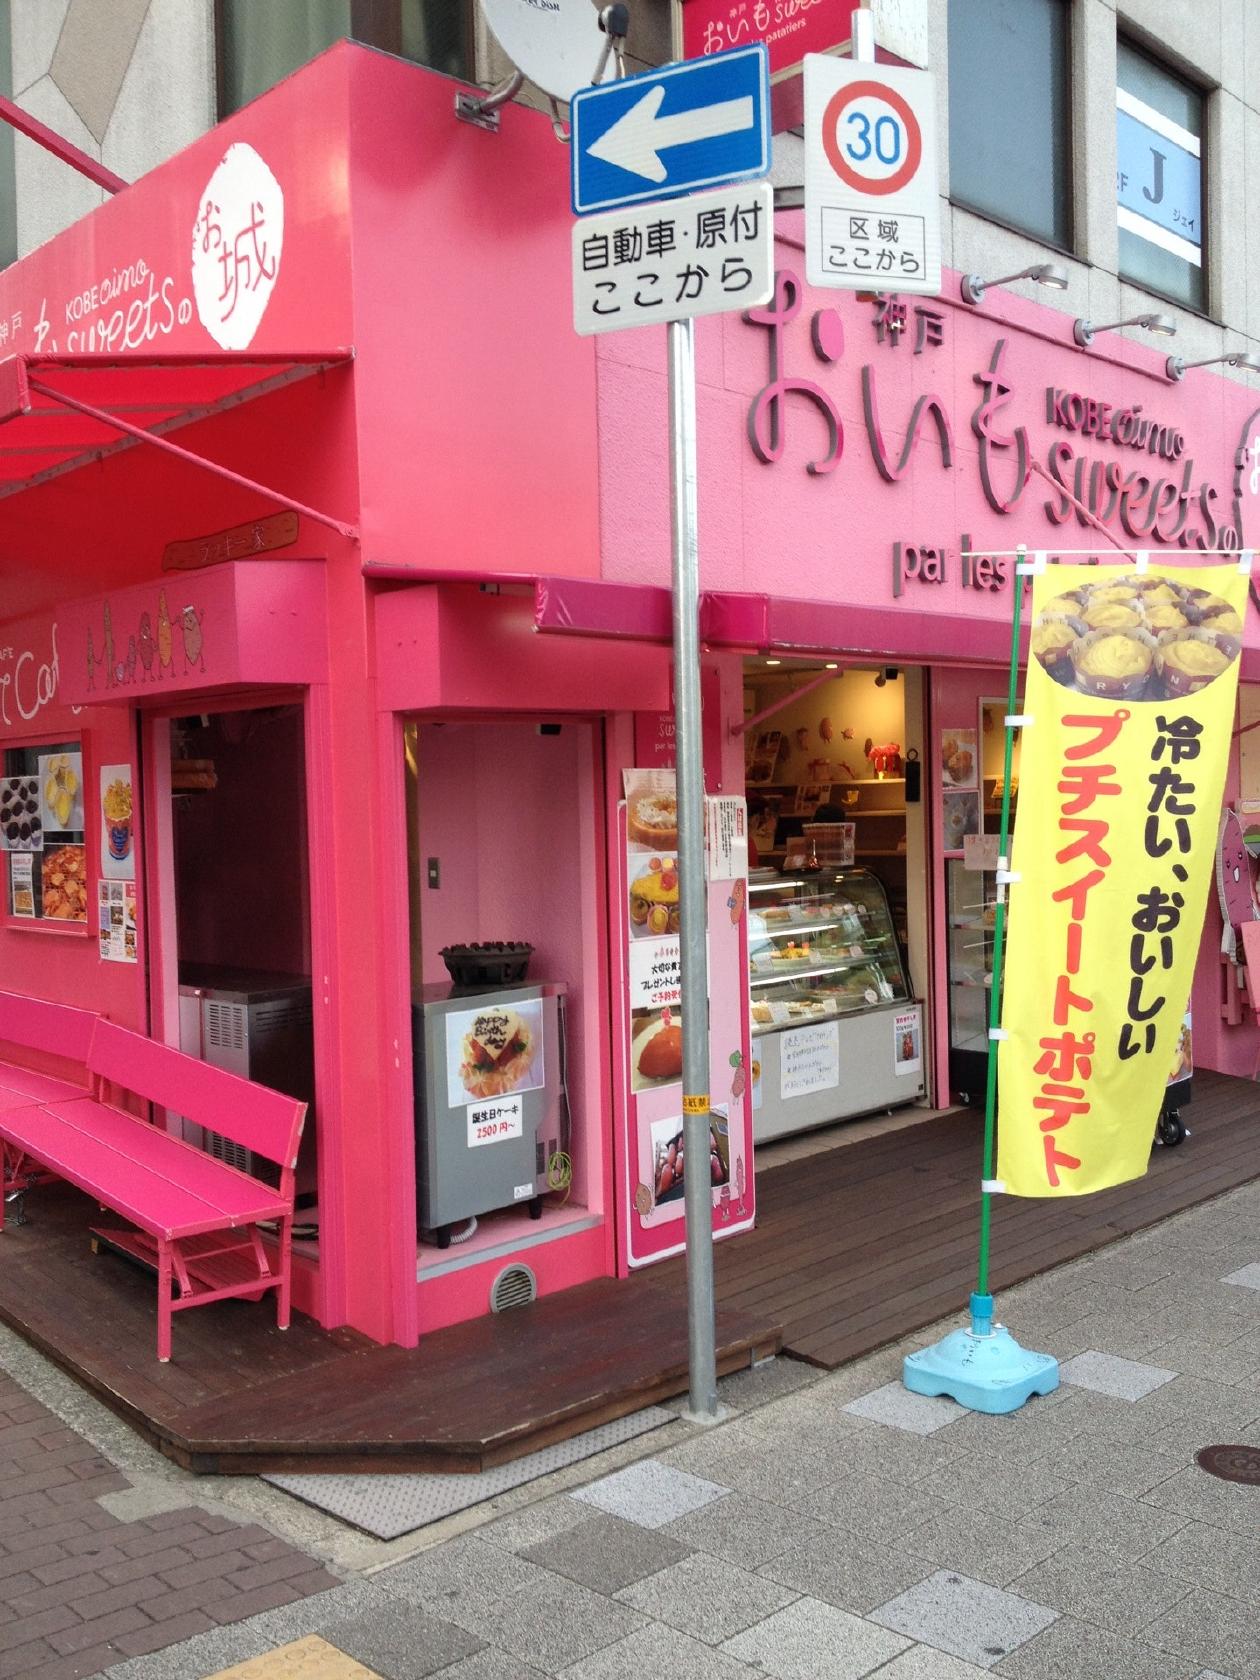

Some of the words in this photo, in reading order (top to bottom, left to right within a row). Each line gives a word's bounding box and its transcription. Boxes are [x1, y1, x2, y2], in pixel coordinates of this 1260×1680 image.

[846, 112, 900, 165] 30
[1142, 146, 1167, 205] J
[849, 217, 899, 244] 区域
[1172, 208, 1195, 232] ジェイ
[196, 200, 276, 323] お城
[828, 244, 920, 274] ここから
[65, 286, 99, 325] KOBE
[592, 257, 753, 316] ここから
[1046, 387, 1112, 440] KOBE
[1118, 715, 1204, 1061] 冷たい、おいしい
[1032, 708, 1131, 1187] プチスイートポテト
[471, 1104, 520, 1125] 誕生日ケーキ
